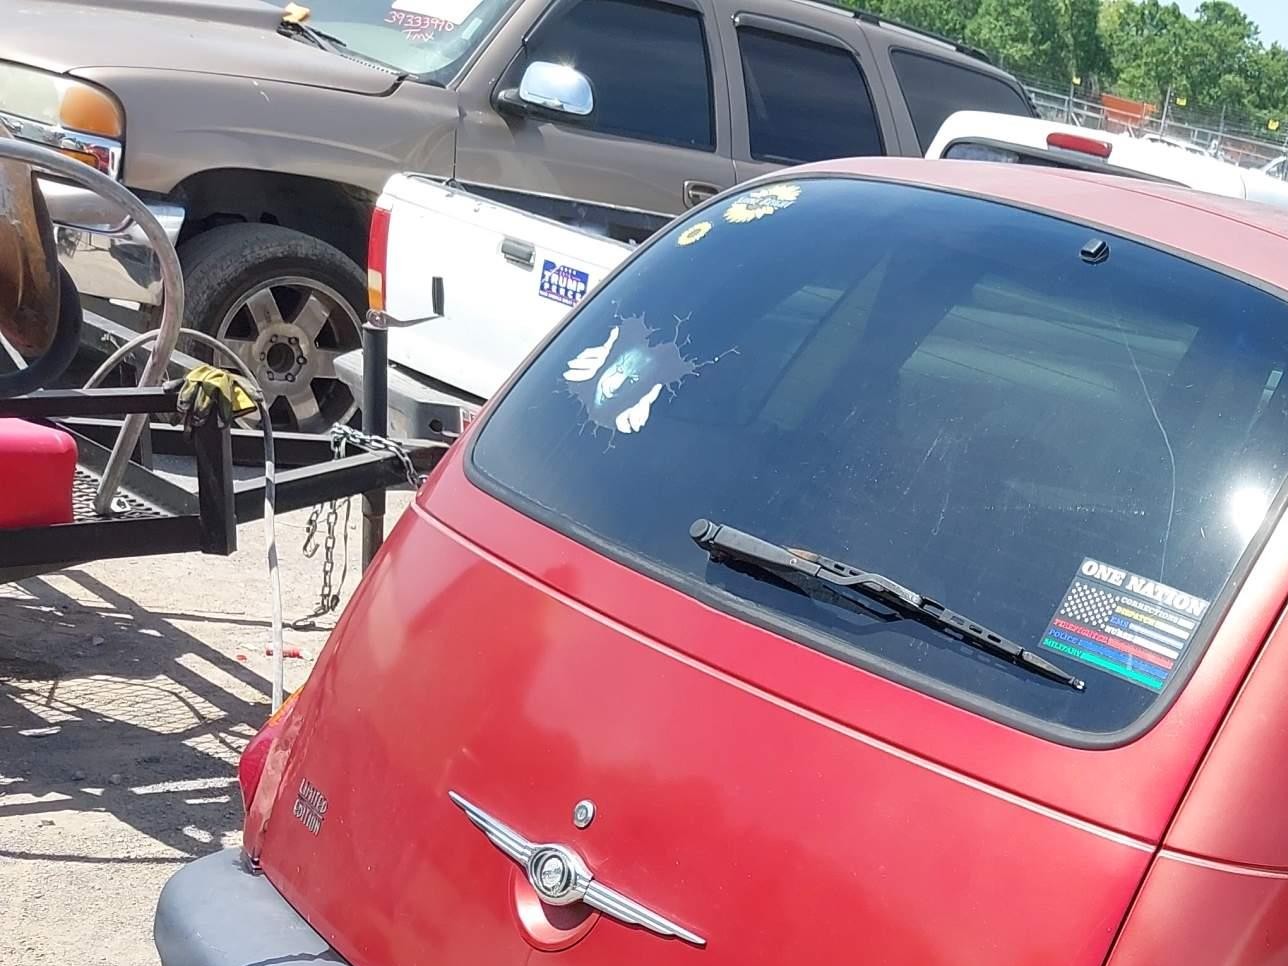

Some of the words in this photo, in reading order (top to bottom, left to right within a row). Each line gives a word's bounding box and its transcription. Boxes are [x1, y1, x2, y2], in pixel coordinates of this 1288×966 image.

[543, 270, 586, 292] TRUMP
[543, 282, 582, 301] PENCE
[1081, 559, 1126, 586] ONE
[1125, 575, 1208, 615] NATION
[1109, 615, 1130, 629] EMS
[1048, 629, 1079, 646] POLICE
[1042, 638, 1083, 659] MILITARY
[299, 778, 328, 814] LIMITED
[293, 799, 321, 836] EDITION
